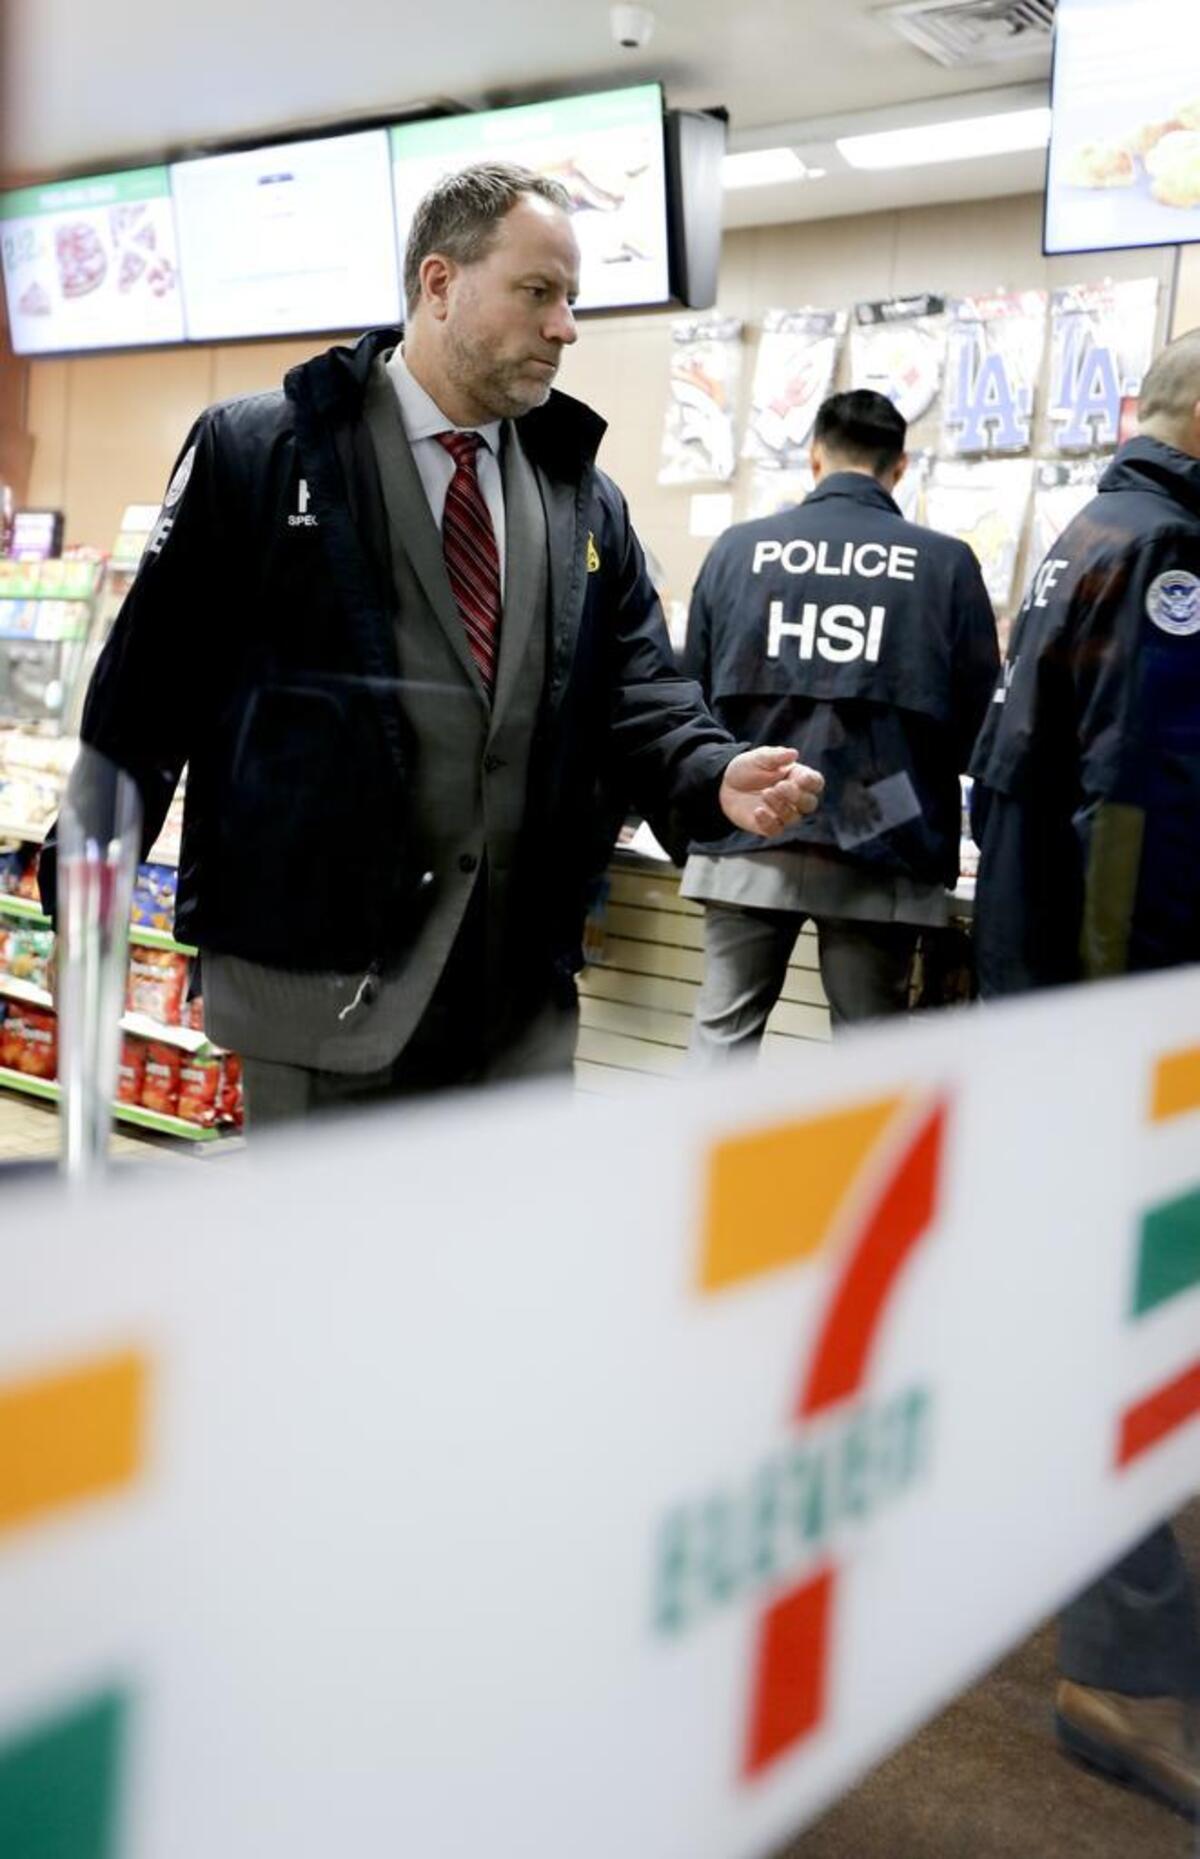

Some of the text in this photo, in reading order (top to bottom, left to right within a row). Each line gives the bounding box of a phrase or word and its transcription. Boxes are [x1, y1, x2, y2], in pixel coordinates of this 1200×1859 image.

[752, 540, 918, 582] POLICE
[767, 600, 886, 663] HSI
[700, 1096, 949, 1782] 7
